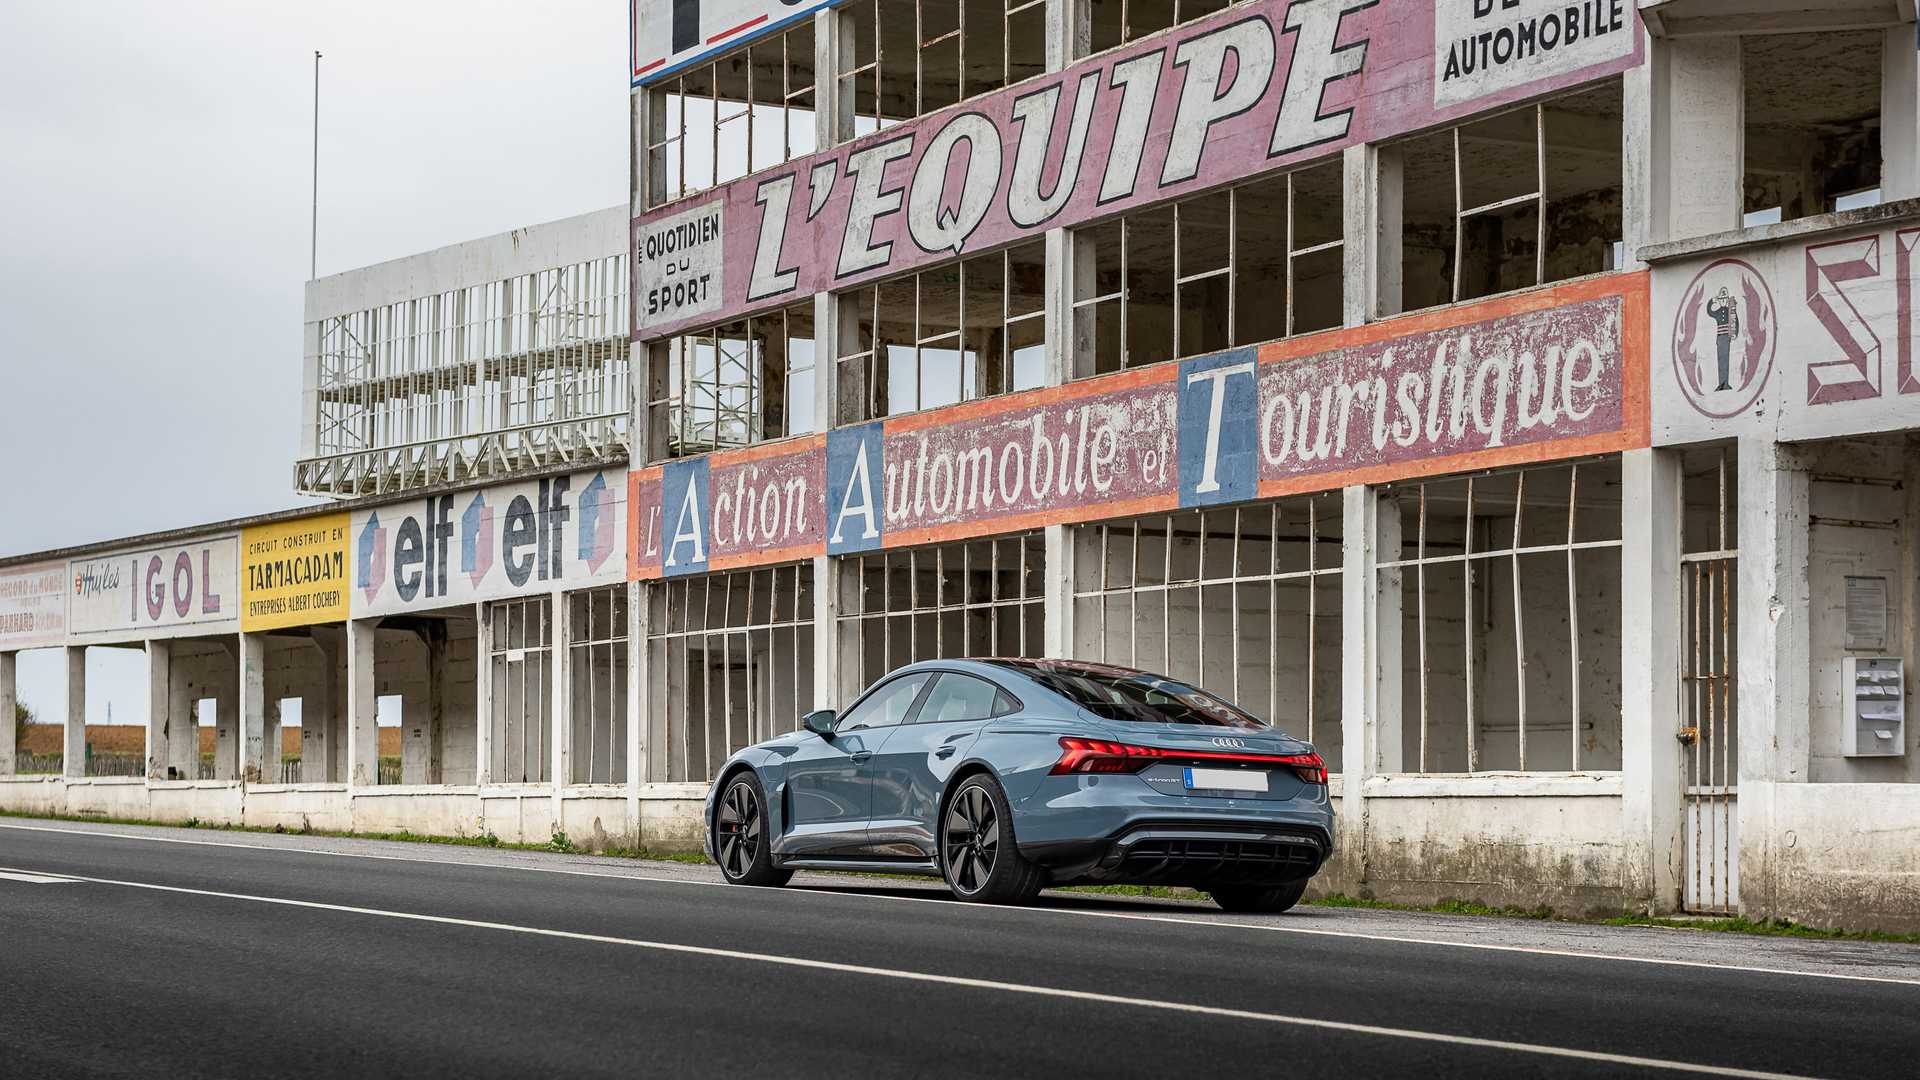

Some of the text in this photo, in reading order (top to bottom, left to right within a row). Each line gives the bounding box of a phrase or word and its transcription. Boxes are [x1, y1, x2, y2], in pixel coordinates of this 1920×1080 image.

[1443, 0, 1623, 81] AUTOMOBILE
[746, 0, 1380, 303] L'EQUIPE
[646, 213, 719, 260] QUOTIDIEN
[666, 257, 690, 276] DU
[648, 274, 710, 315] SPORT
[829, 404, 1117, 544] Automobile
[1186, 335, 1600, 493] Touristique
[249, 527, 343, 555] CIRCUIT CONSTRUIT EN
[393, 475, 571, 602] elf elf
[82, 563, 120, 600] Huiles
[131, 549, 220, 622] IGOL
[249, 550, 343, 592] TARMACADAM
[249, 589, 341, 617] ENTREPRISES ALBERT COCHERY
